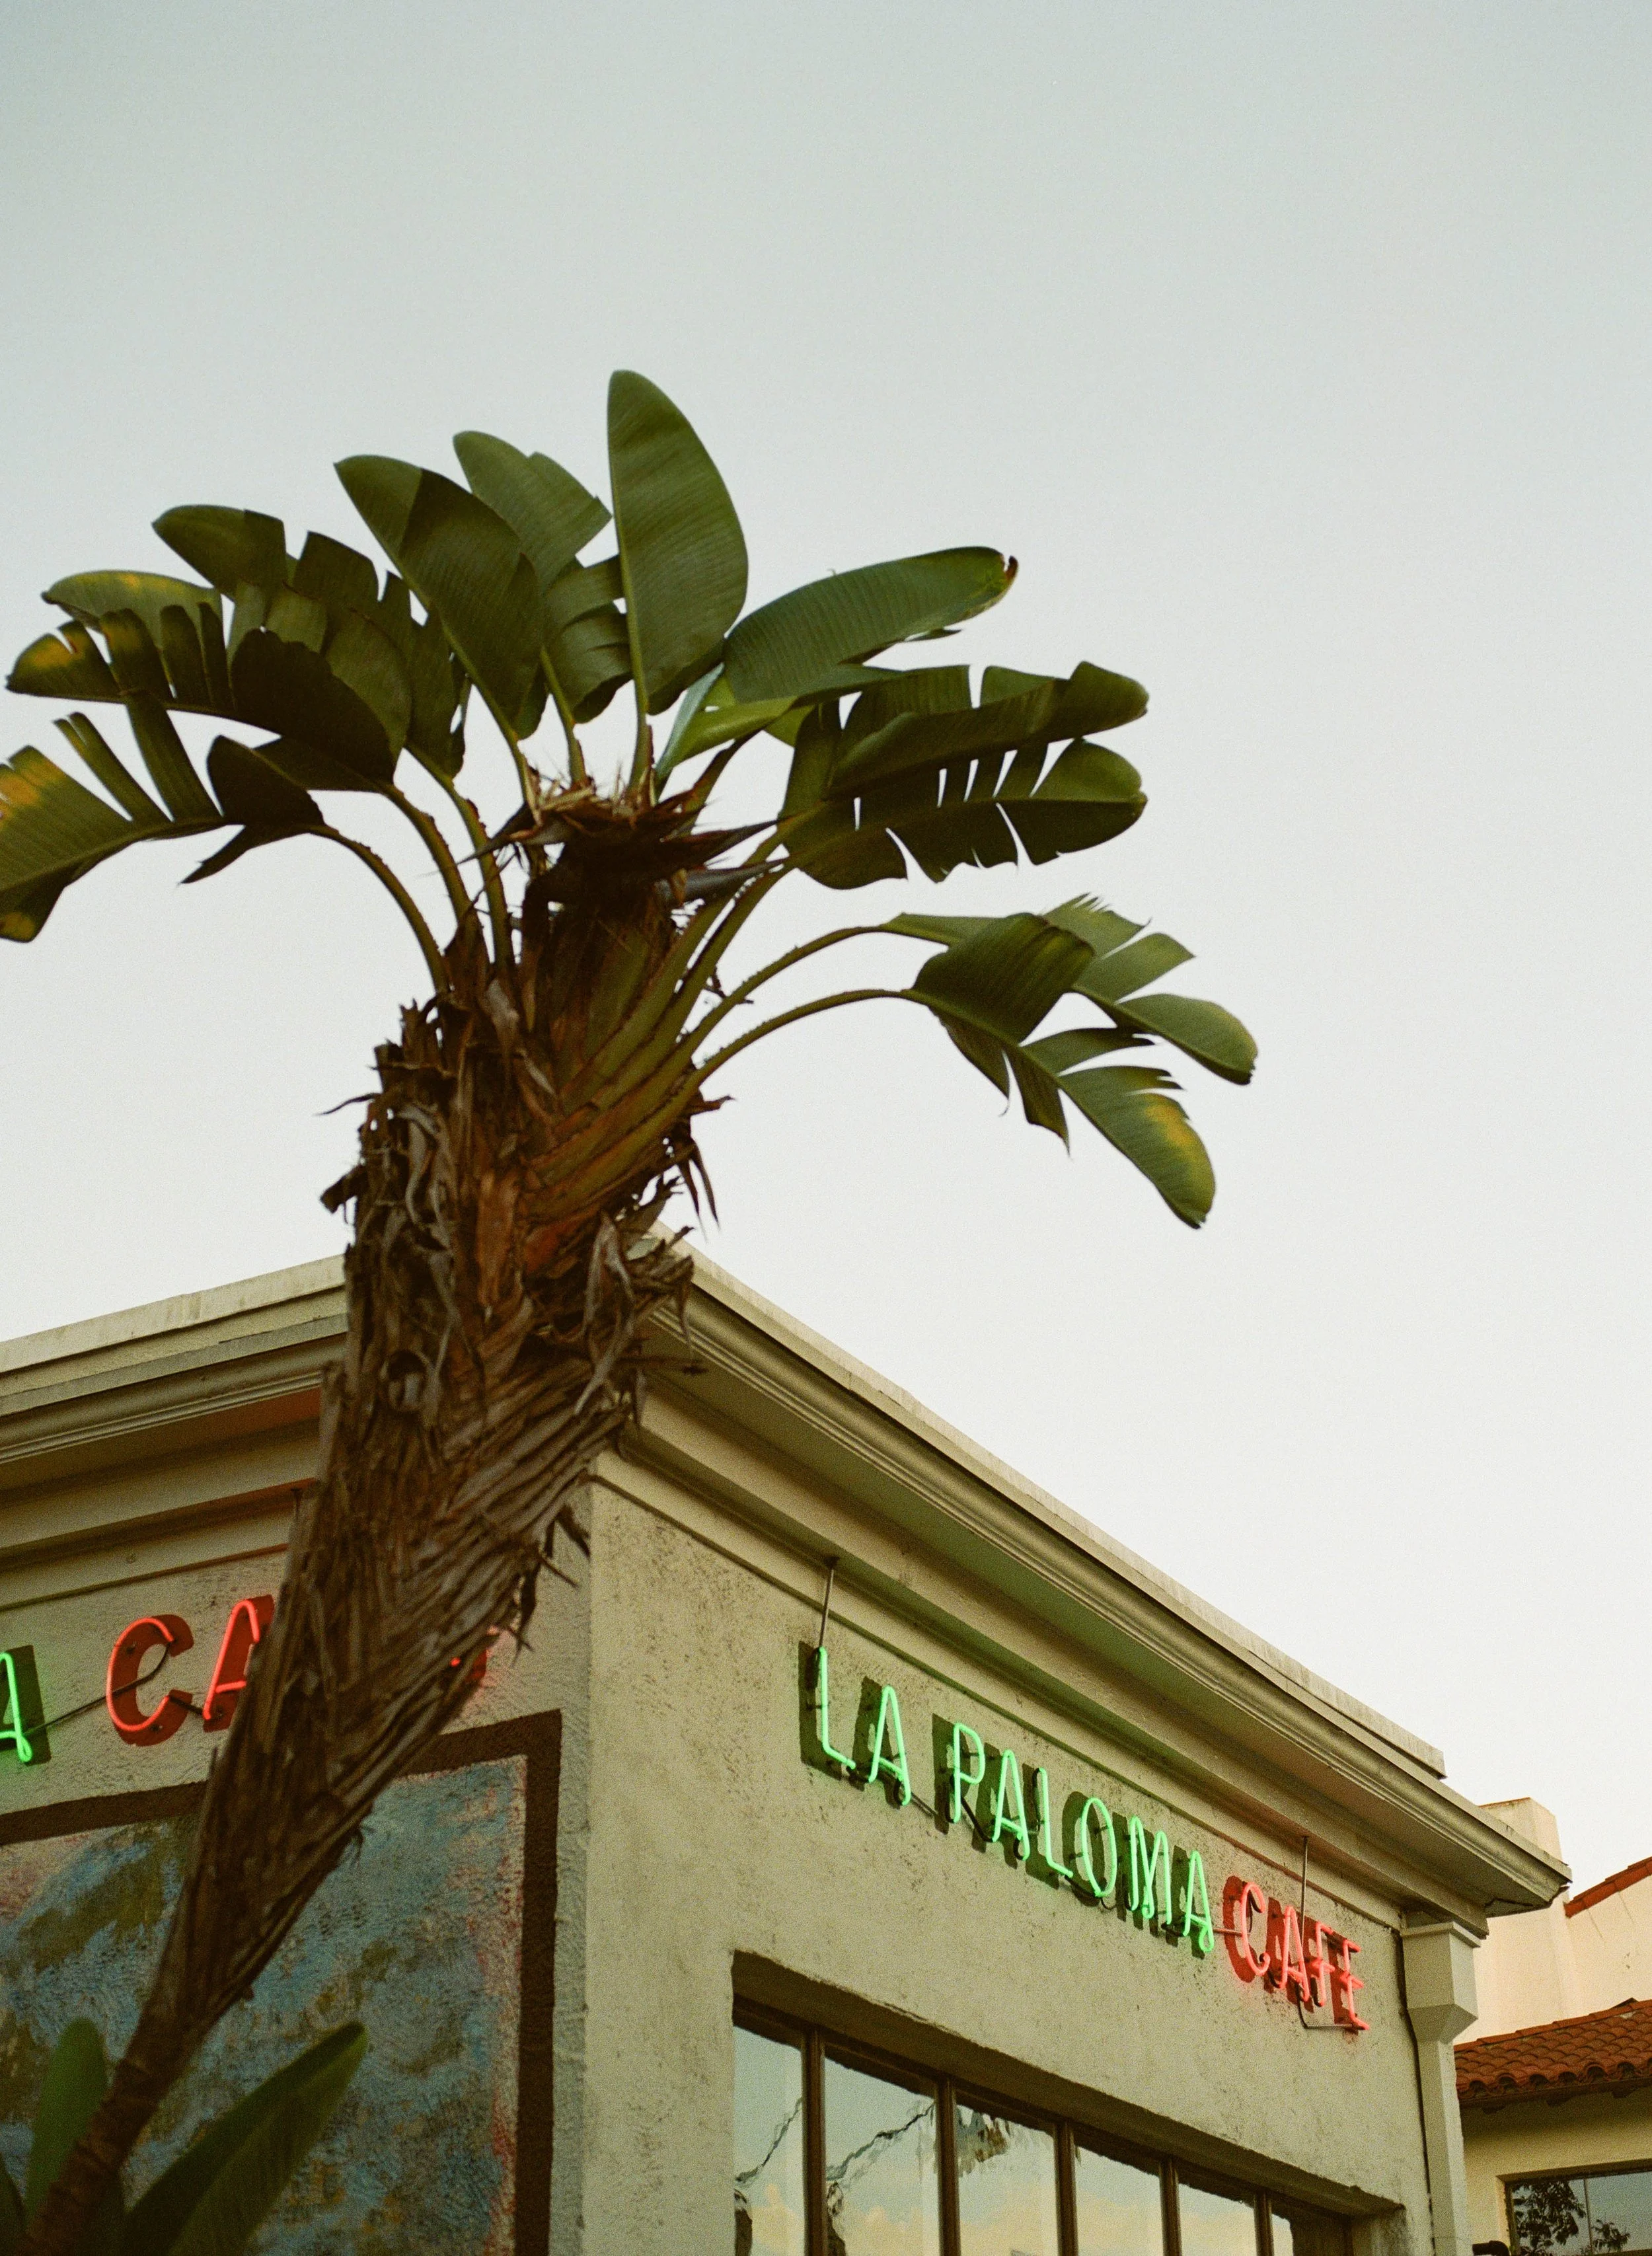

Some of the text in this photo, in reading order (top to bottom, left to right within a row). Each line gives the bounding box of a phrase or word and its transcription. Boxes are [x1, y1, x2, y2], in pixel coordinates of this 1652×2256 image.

[817, 1645, 1370, 2031] LA PALOMA CAFE
